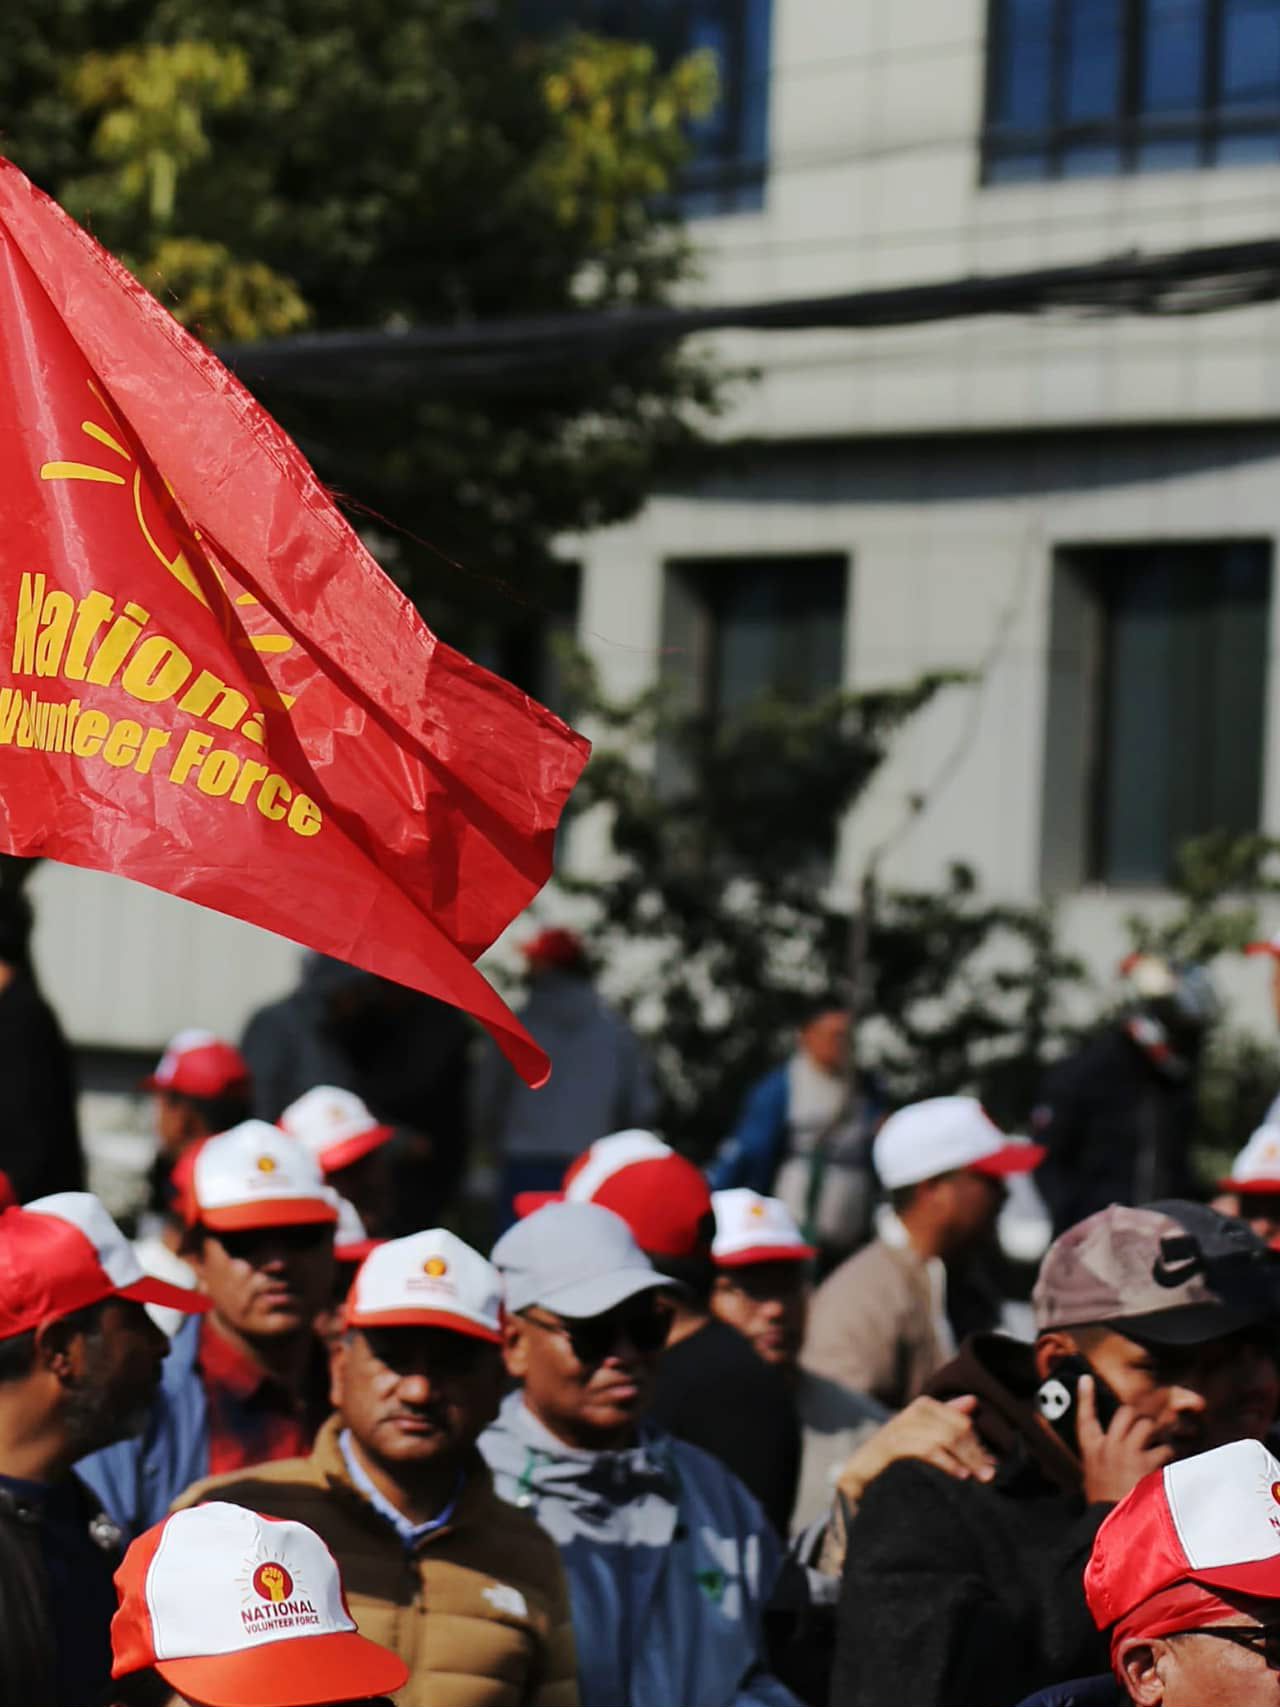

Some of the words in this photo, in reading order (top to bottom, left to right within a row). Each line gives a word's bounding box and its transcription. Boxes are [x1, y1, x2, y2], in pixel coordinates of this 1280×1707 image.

[12, 572, 266, 746] Nation
[169, 728, 323, 837] Force
[241, 1599, 317, 1624] NATIONAL
[245, 1618, 295, 1635] VOLUNTEER
[296, 1615, 320, 1625] FORCE
